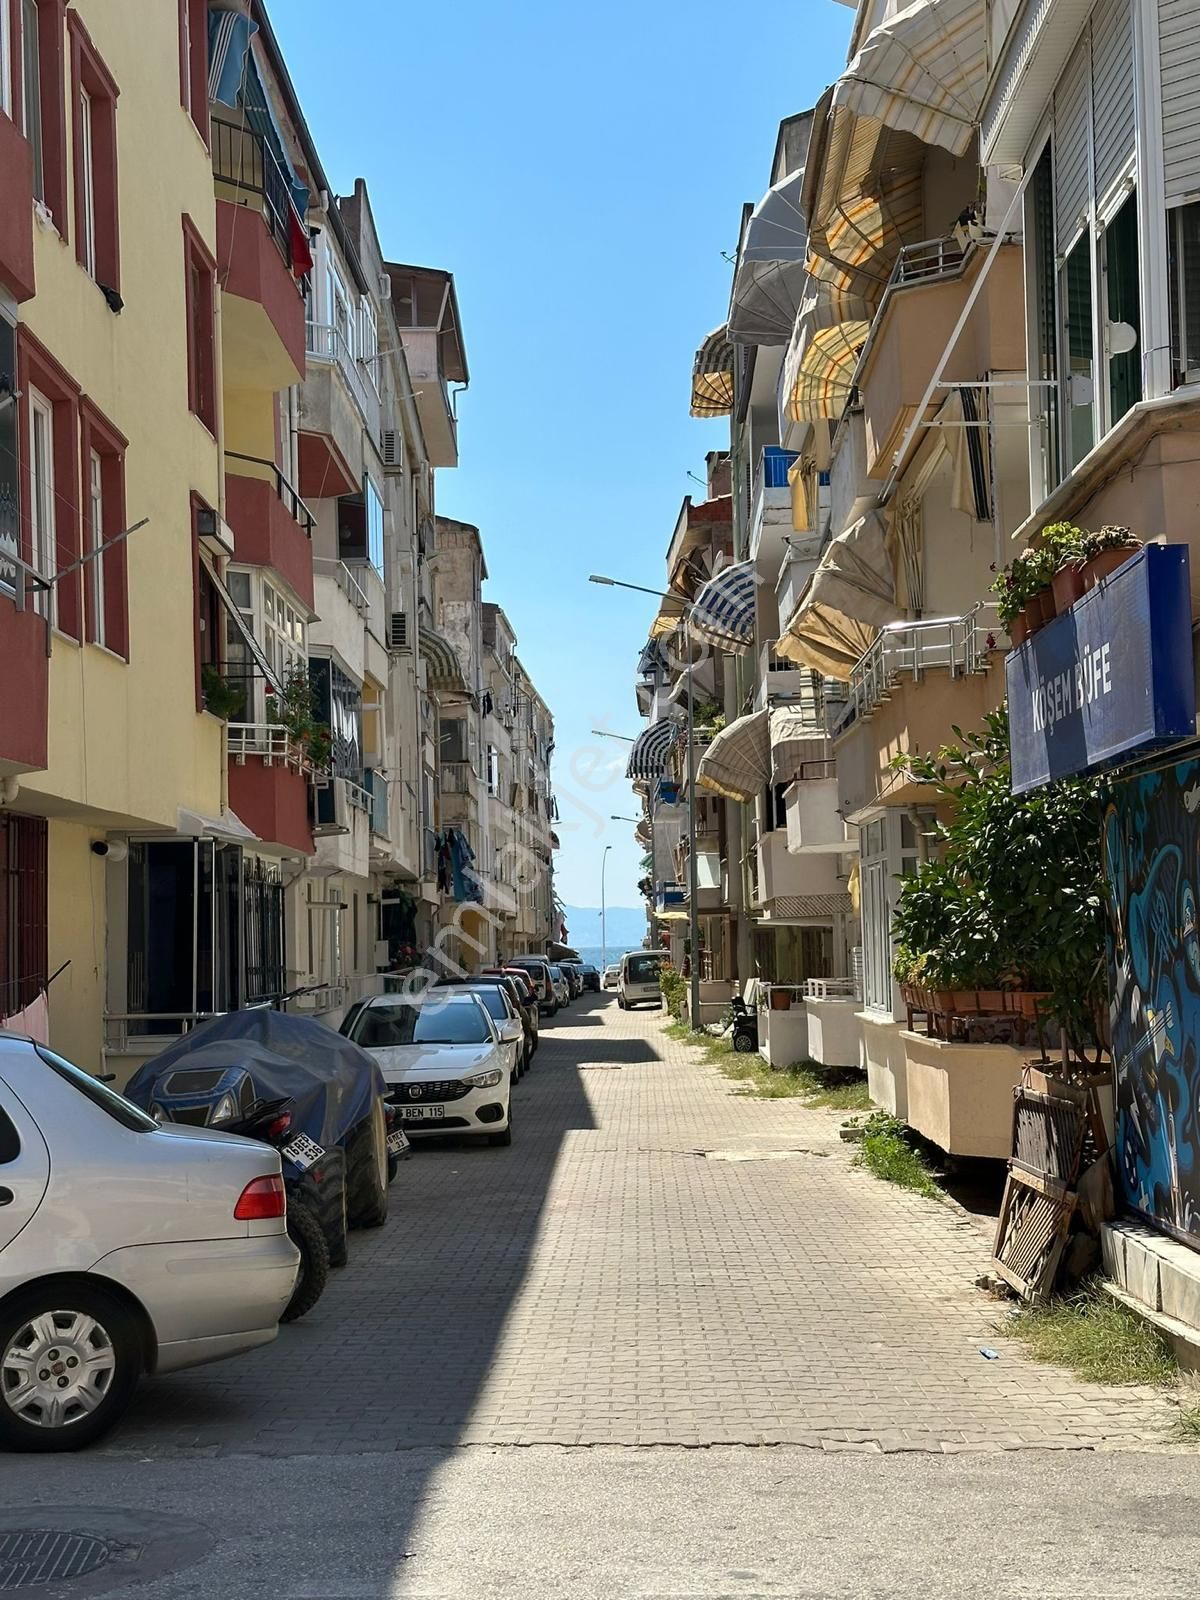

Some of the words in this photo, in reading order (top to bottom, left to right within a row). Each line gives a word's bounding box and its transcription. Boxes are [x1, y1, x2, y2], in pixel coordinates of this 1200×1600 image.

[1032, 669, 1072, 736] KÖŞEM
[1075, 642, 1112, 709] BÜFE
[406, 1107, 424, 1117] BEN
[429, 1107, 443, 1117] 115
